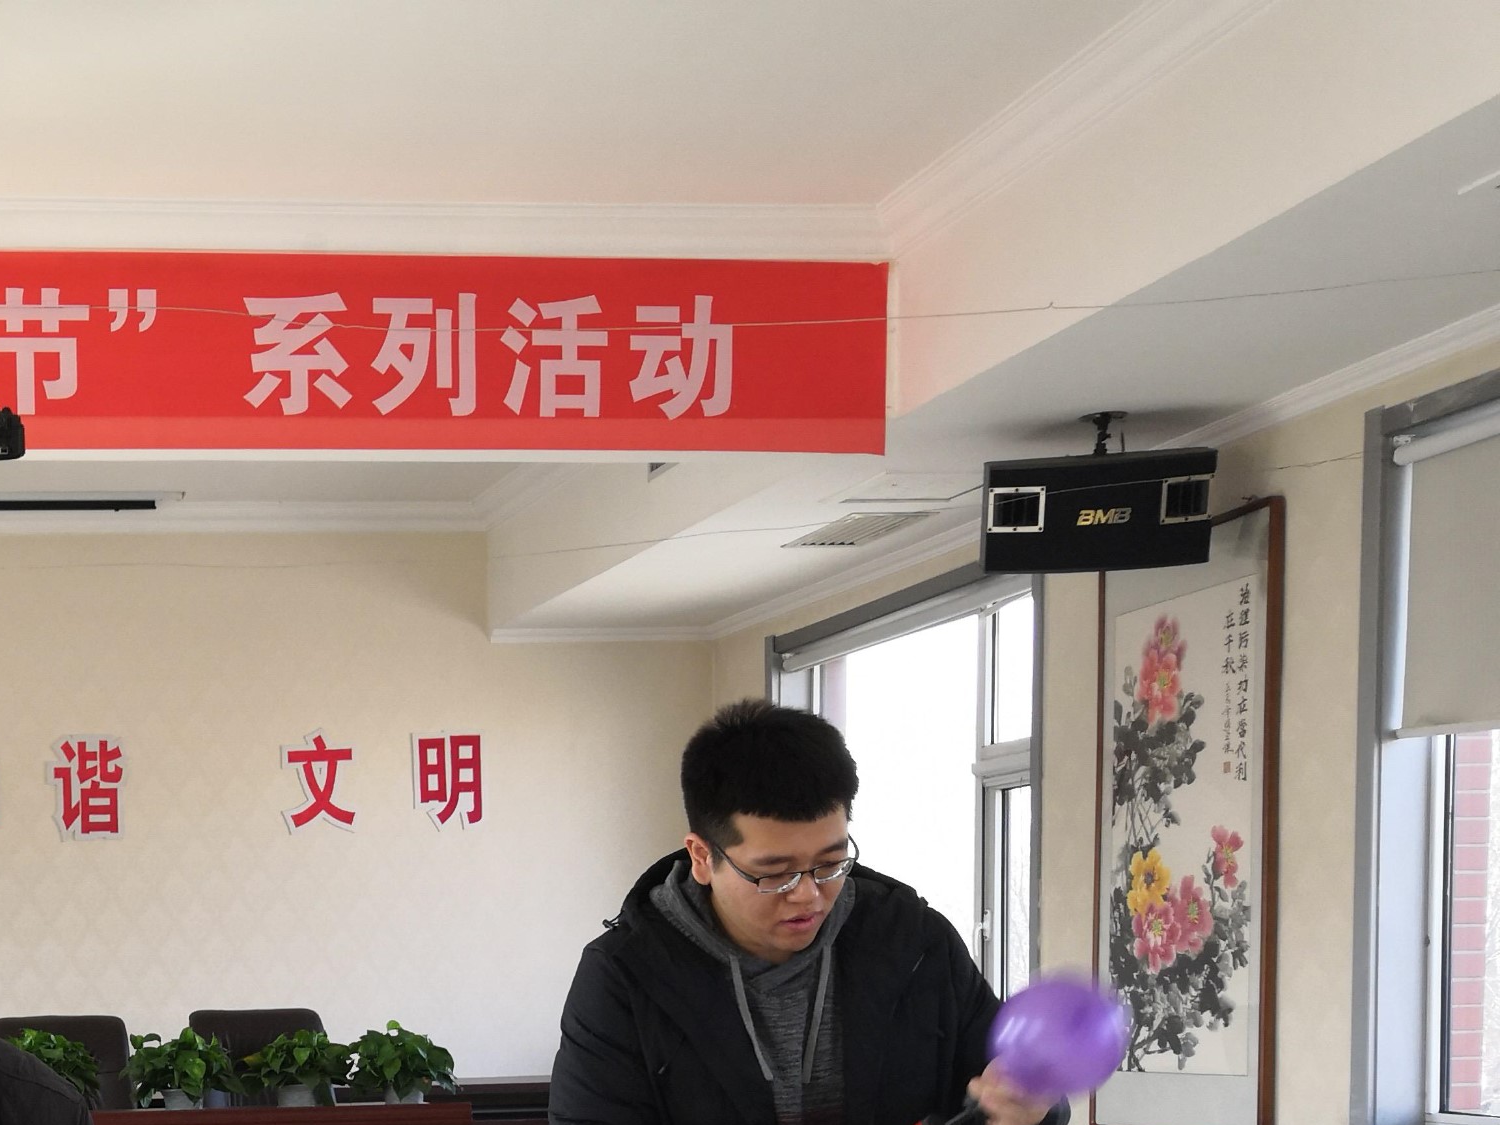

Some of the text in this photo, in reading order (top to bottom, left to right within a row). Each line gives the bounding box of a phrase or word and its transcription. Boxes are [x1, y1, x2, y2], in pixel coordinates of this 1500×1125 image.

[243, 292, 733, 419] 系列活动
[1076, 507, 1132, 526] BMB
[286, 733, 483, 827] 文明
